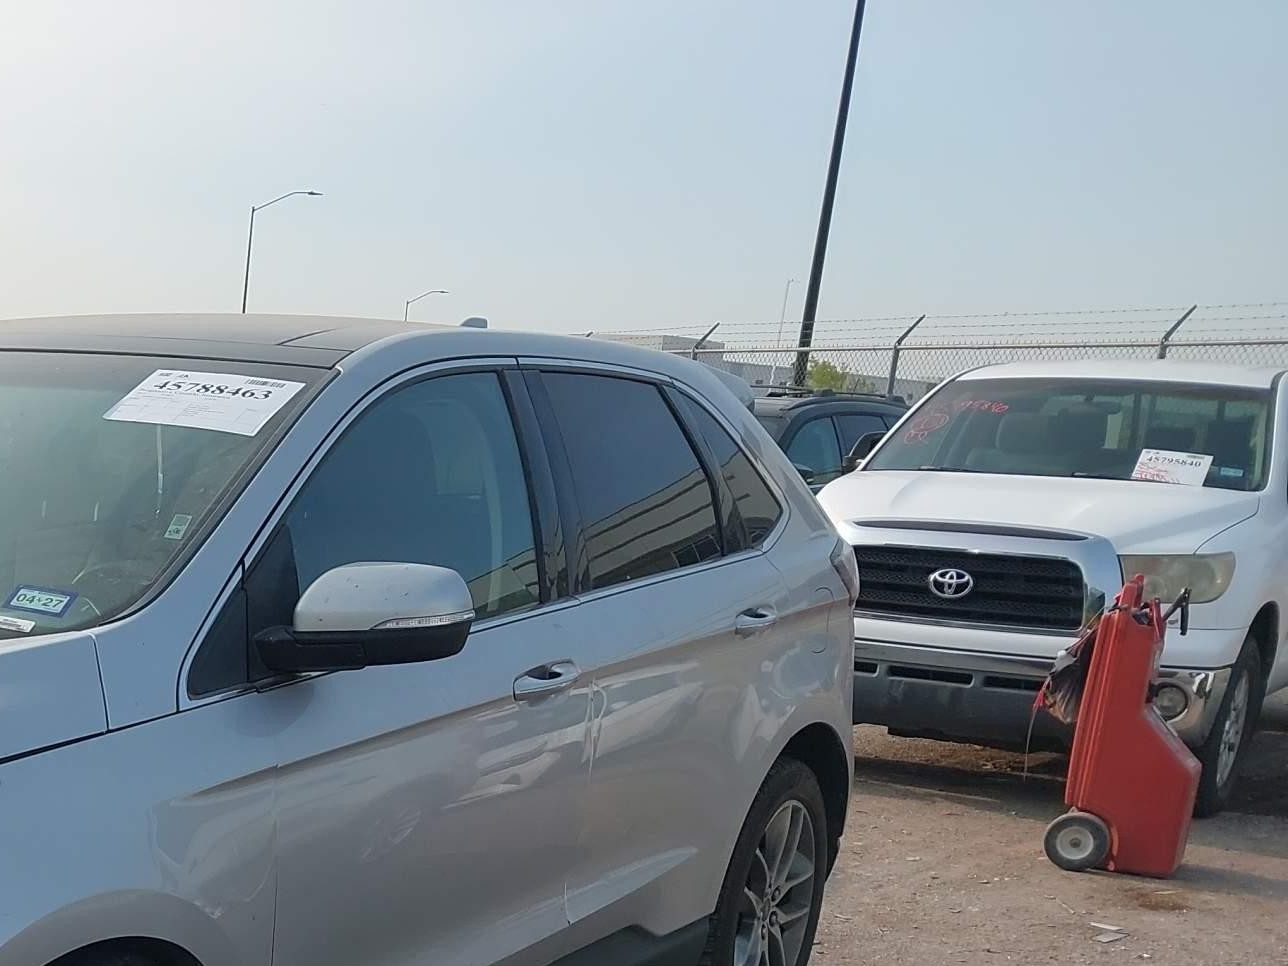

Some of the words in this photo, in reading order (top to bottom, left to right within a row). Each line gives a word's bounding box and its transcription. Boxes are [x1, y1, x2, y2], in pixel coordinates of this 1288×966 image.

[154, 379, 272, 400] 45788463
[16, 593, 35, 604] 04
[42, 597, 64, 608] 27
